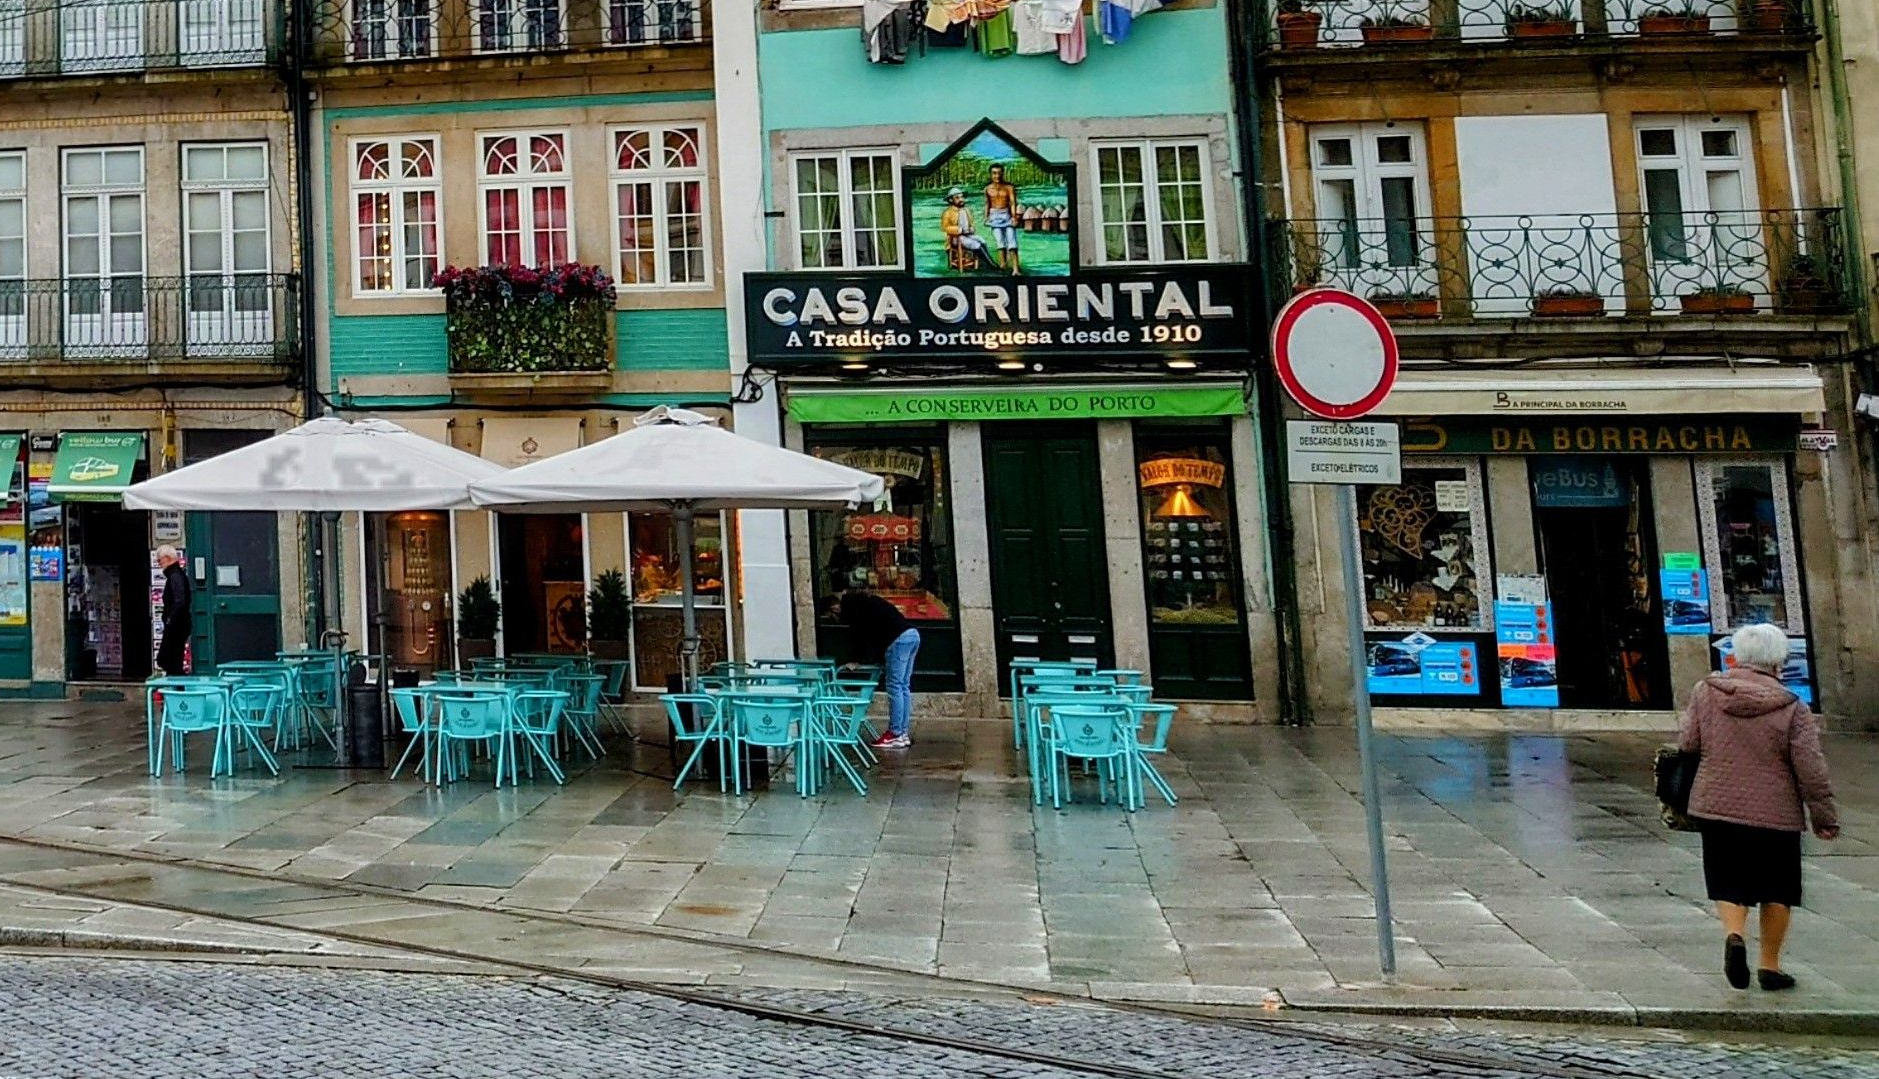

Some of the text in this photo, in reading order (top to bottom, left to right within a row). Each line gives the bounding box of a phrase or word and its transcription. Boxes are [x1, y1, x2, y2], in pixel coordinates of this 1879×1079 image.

[763, 280, 1234, 326] CASA ORIENTAL
[786, 324, 1202, 351] A Tradição Portuguesa desde 1910
[888, 400, 901, 414] A
[906, 397, 1039, 415] CONSERVEIRA
[1049, 396, 1079, 412] DO
[1089, 395, 1156, 411] PORTO
[1521, 400, 1564, 409] PRINCIPAL
[1565, 400, 1578, 408] DA
[1579, 400, 1627, 408] BORRACHA
[1311, 425, 1375, 435] EXCETO CARGAS E
[1299, 437, 1342, 446] DESCARGAS
[1343, 438, 1359, 447] DAS
[1492, 426, 1752, 450] DA BORRACHA
[1311, 463, 1339, 472] EXCETO
